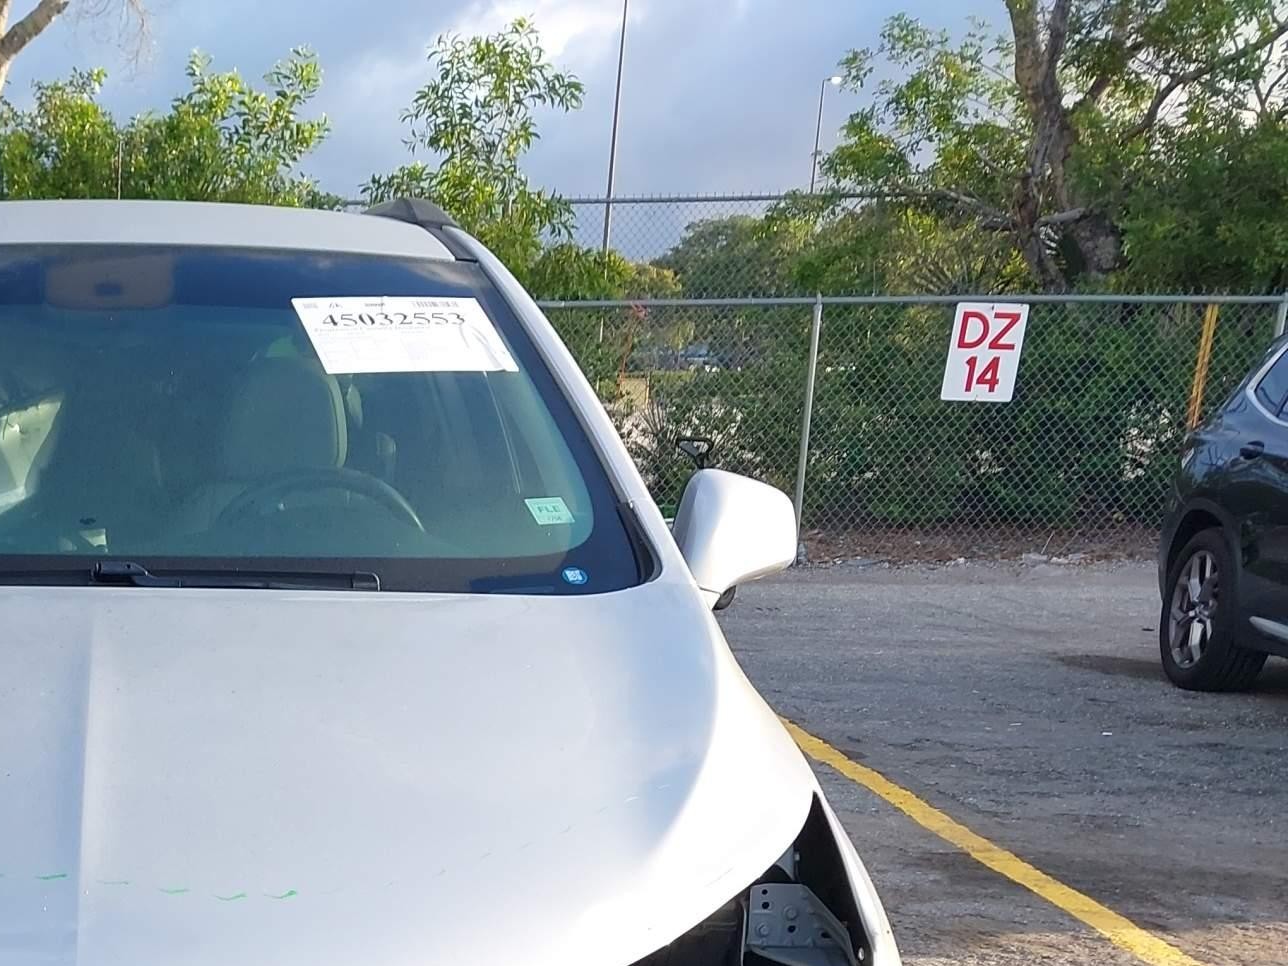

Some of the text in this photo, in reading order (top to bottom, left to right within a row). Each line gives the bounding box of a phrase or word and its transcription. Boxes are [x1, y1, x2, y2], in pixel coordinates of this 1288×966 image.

[322, 311, 466, 328] 45032553
[957, 311, 1022, 350] DZ
[965, 356, 1001, 393] 14
